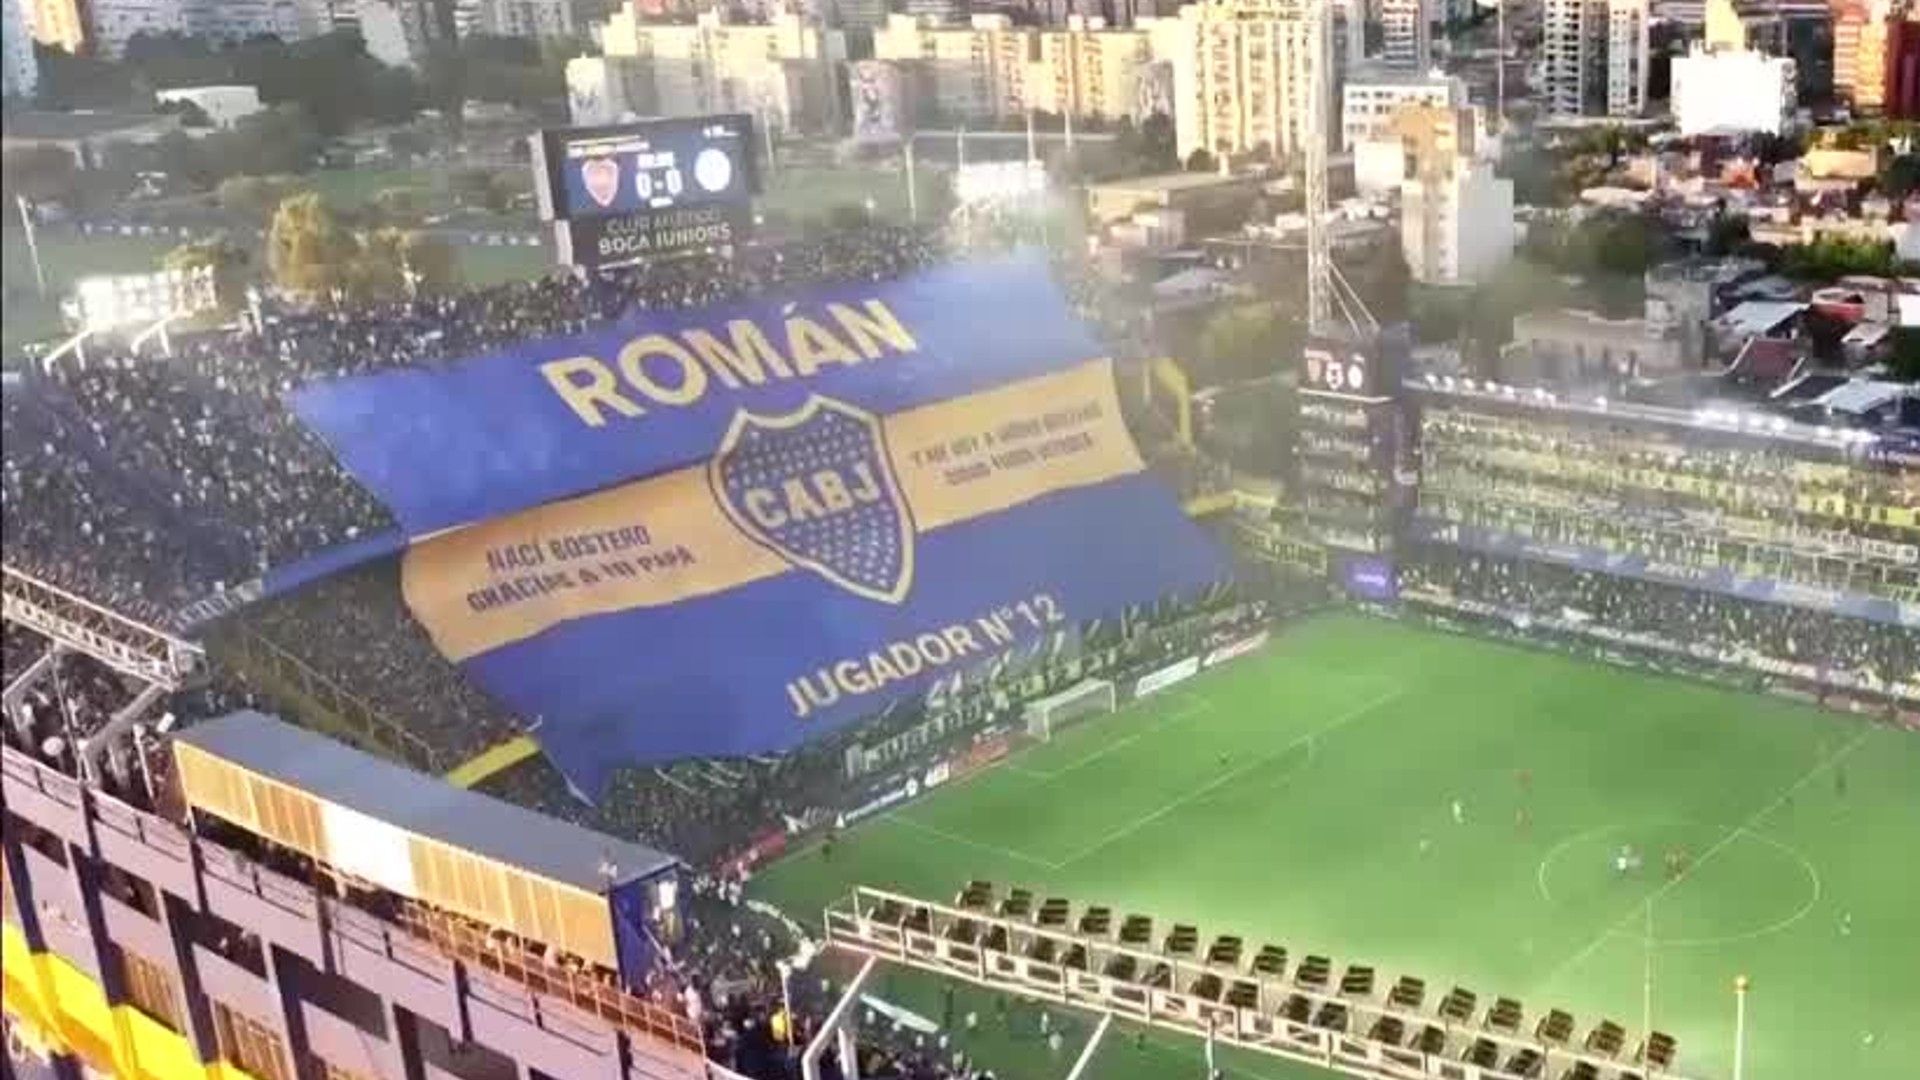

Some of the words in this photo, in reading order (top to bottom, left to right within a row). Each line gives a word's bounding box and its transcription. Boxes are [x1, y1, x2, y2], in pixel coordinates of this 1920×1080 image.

[599, 235, 651, 254] BOCA
[540, 299, 917, 427] ROMÁN
[745, 462, 881, 528] CABJ
[550, 524, 650, 561] BOSTERO
[786, 625, 983, 718] JUGADOR
[1016, 593, 1066, 628] 12
